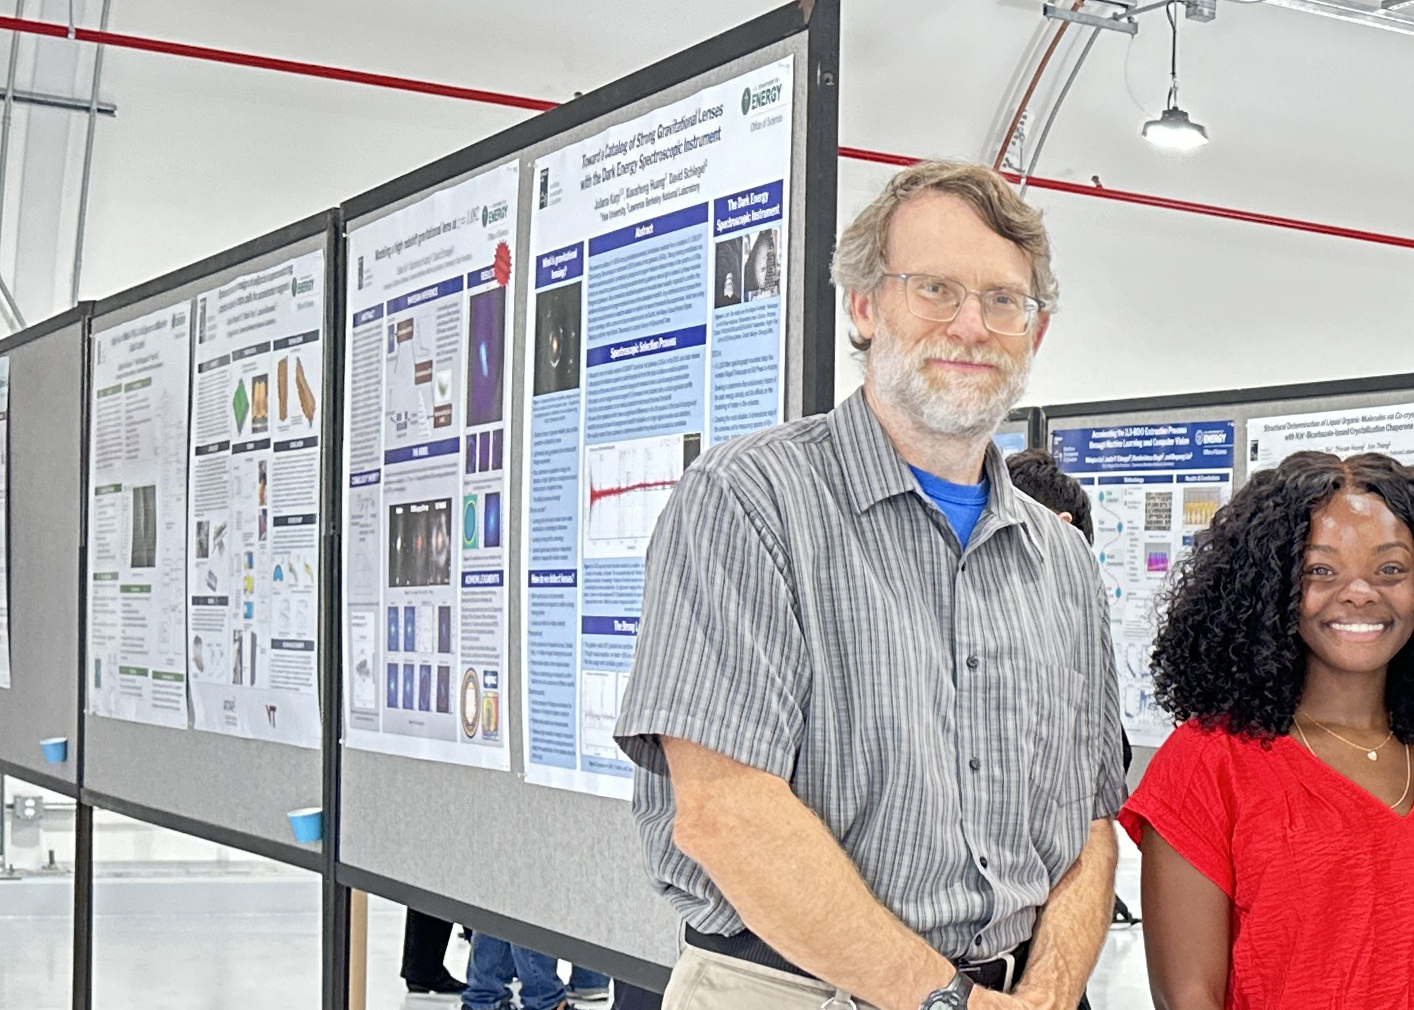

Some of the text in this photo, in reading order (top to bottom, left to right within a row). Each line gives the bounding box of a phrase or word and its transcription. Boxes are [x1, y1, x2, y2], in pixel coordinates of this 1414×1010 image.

[752, 84, 782, 110] ENERGY
[629, 134, 636, 150] of
[636, 130, 656, 148] Strong
[657, 110, 697, 140] Gravitational
[592, 172, 601, 186] the
[602, 164, 616, 182] Dark
[616, 160, 638, 176] Energy
[638, 140, 683, 170] Spectroscopic
[684, 126, 722, 154] Instrument
[727, 190, 769, 212] The Dark Energy
[717, 204, 780, 232] Spectroscopic Instrument
